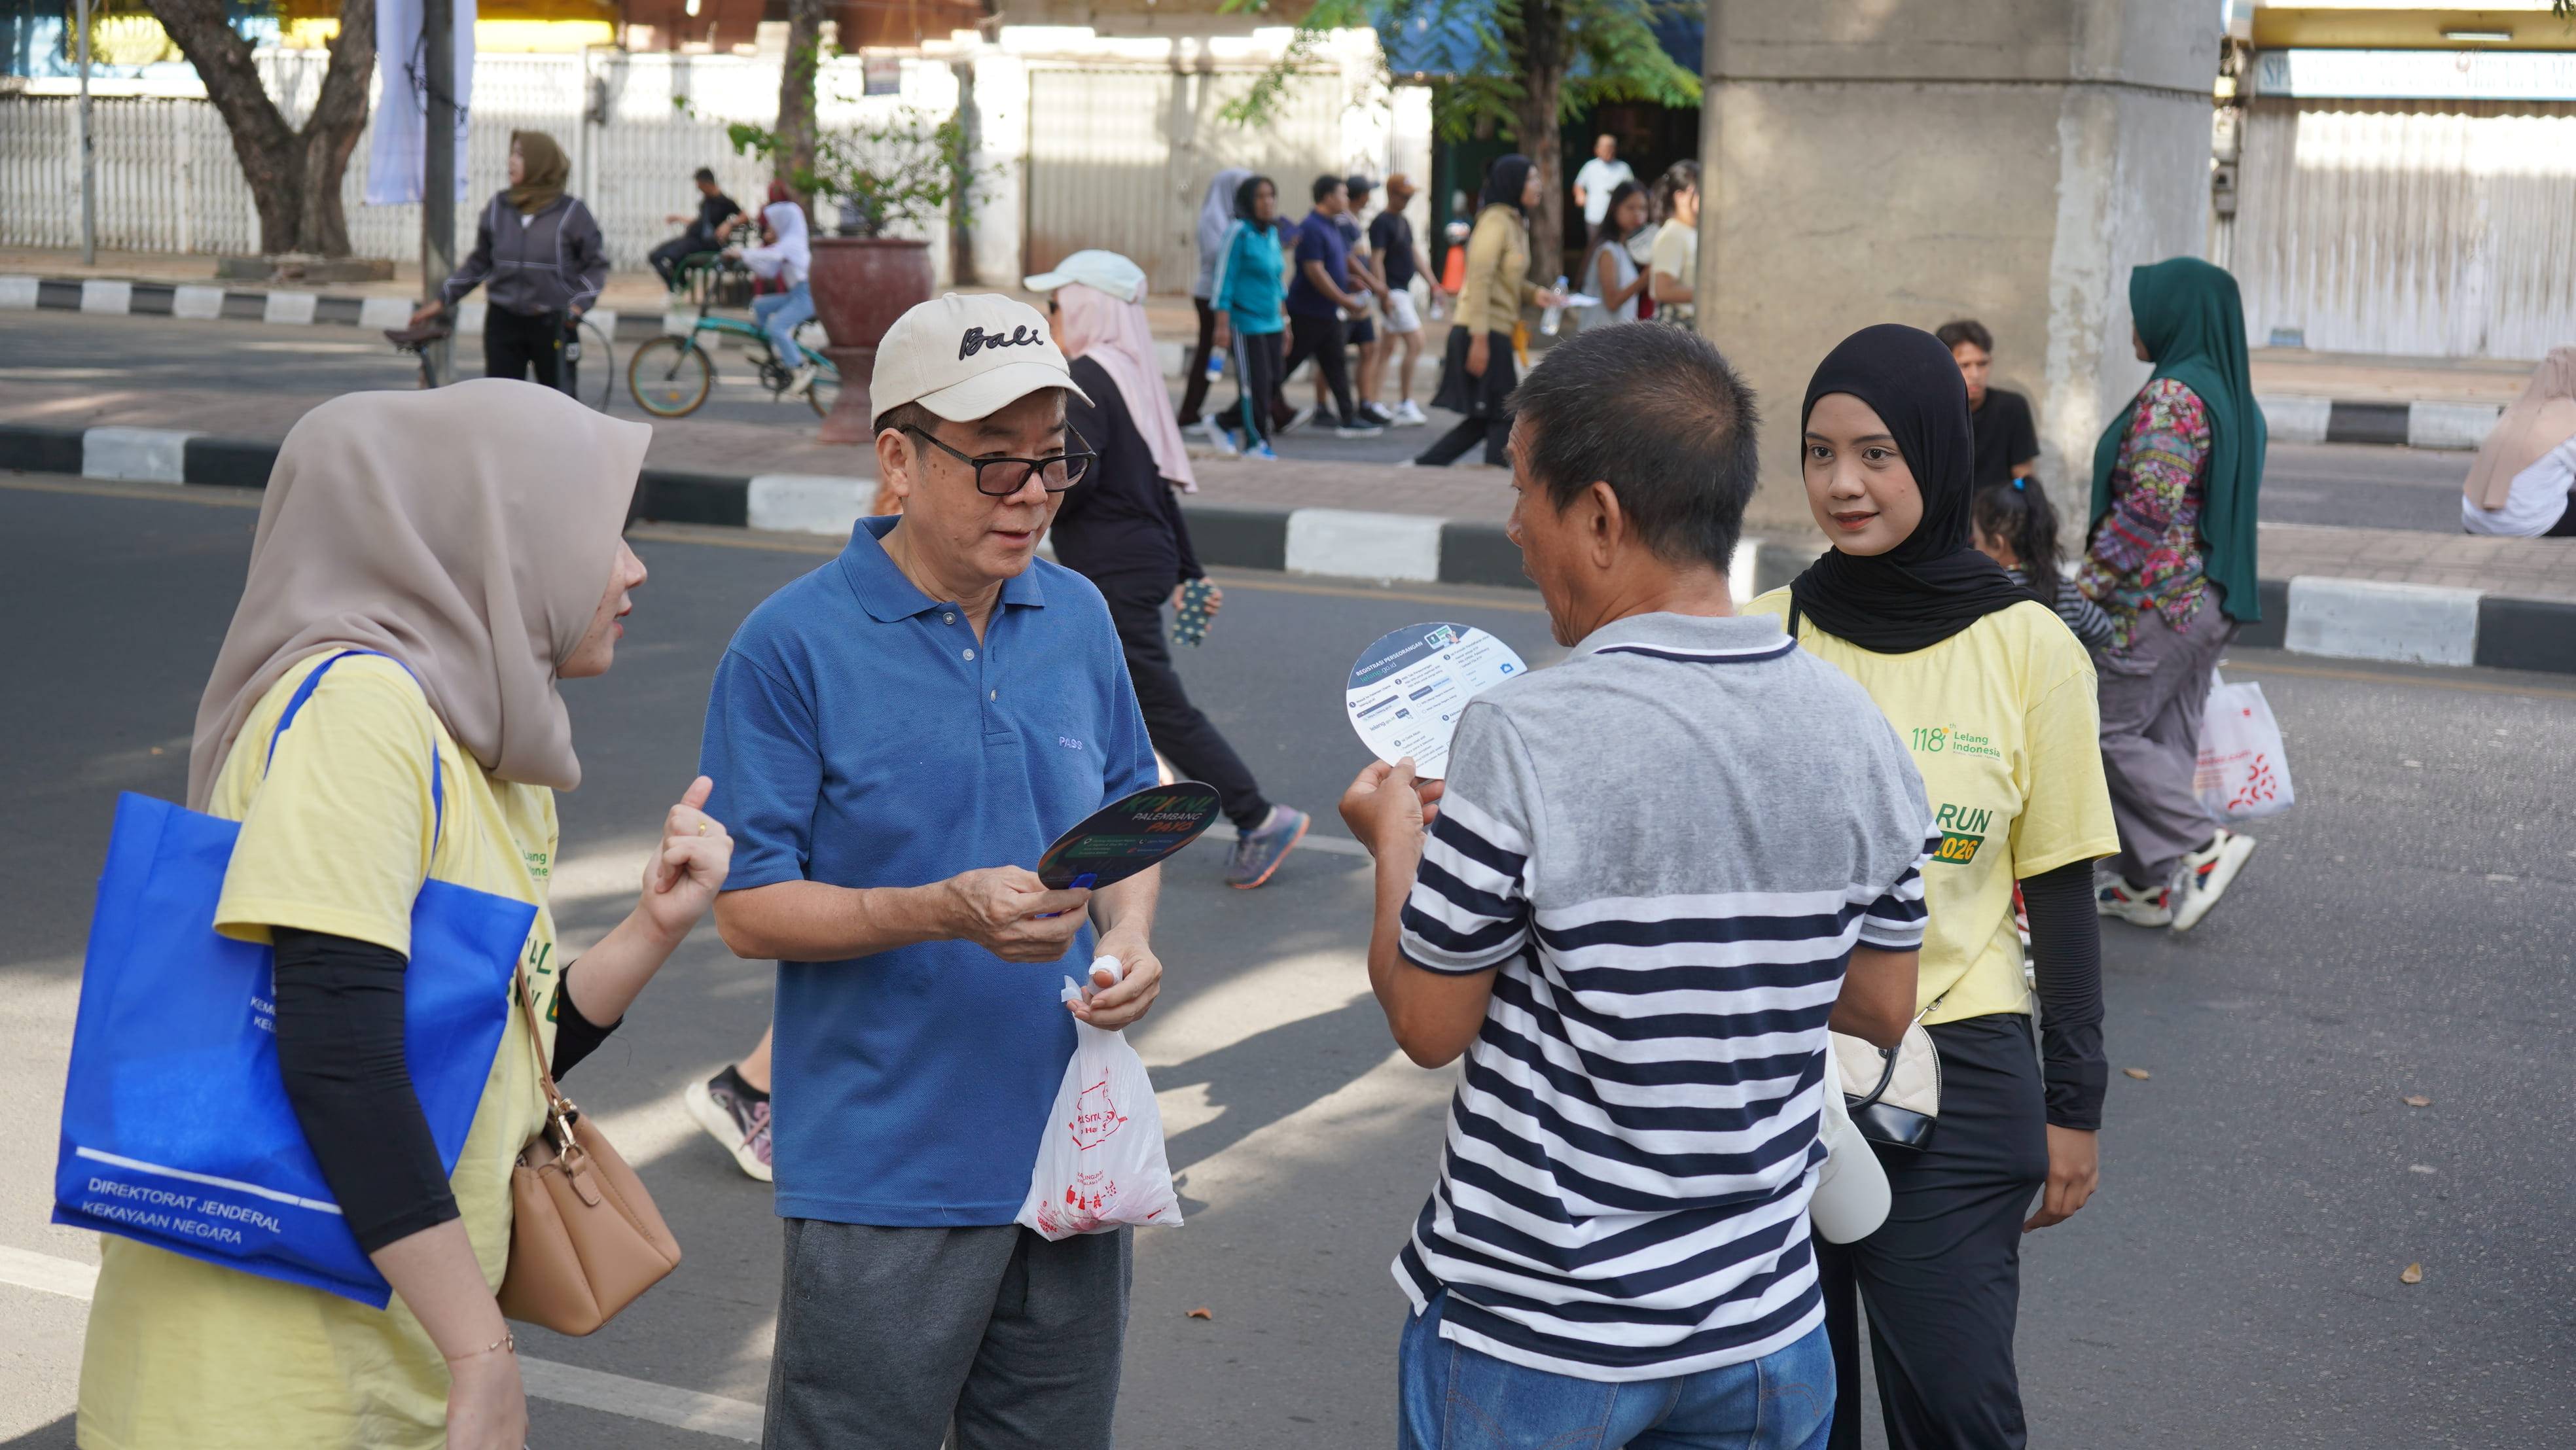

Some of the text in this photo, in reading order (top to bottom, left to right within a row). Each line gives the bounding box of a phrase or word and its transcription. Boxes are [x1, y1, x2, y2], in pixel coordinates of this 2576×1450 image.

[959, 325, 1044, 361] Bali
[1356, 660, 1384, 677] REGISTRASI
[1384, 641, 1423, 663] PERSEORANGAN
[1912, 728, 1944, 752] 118
[1954, 732, 1989, 745] Lelang
[1953, 741, 2001, 758] Indonesia
[1118, 794, 1216, 813] KPKNL
[1132, 812, 1203, 821] PALEMBANG
[1936, 804, 1993, 833] RUN
[1933, 837, 1978, 860] 026
[88, 1177, 281, 1233] DIREKTORAT JENDERAL
[81, 1201, 242, 1245] KEKAYAAN NEGARA
